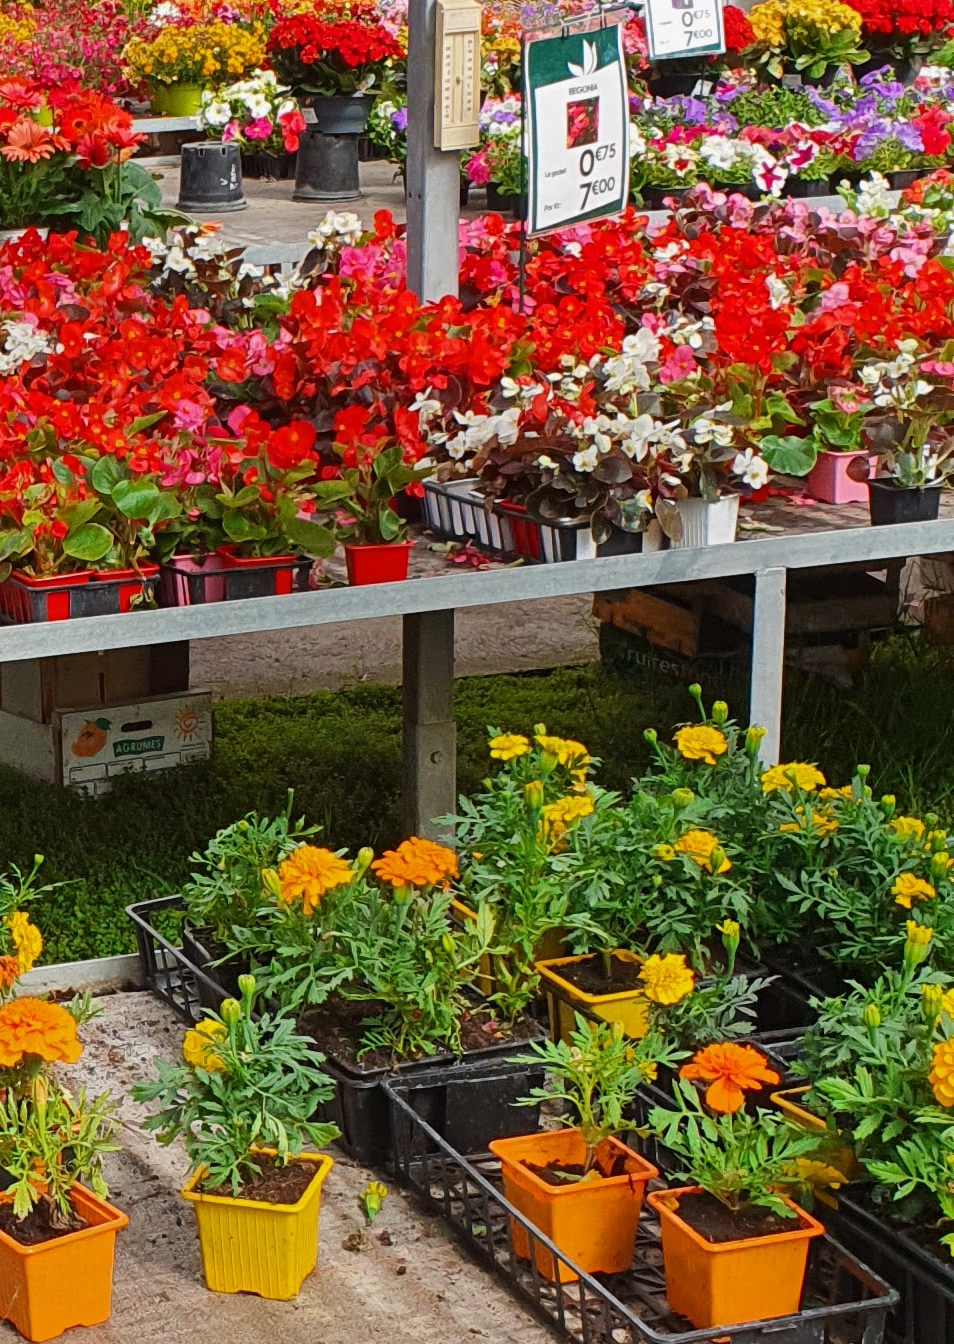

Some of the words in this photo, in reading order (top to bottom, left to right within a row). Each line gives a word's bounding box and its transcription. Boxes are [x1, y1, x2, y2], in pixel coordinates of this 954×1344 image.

[684, 29, 713, 47] 7€00
[568, 83, 598, 96] BEGONIA
[579, 143, 616, 177] 0€75
[579, 176, 616, 211] 7€00
[115, 739, 161, 754] AGRUMES
